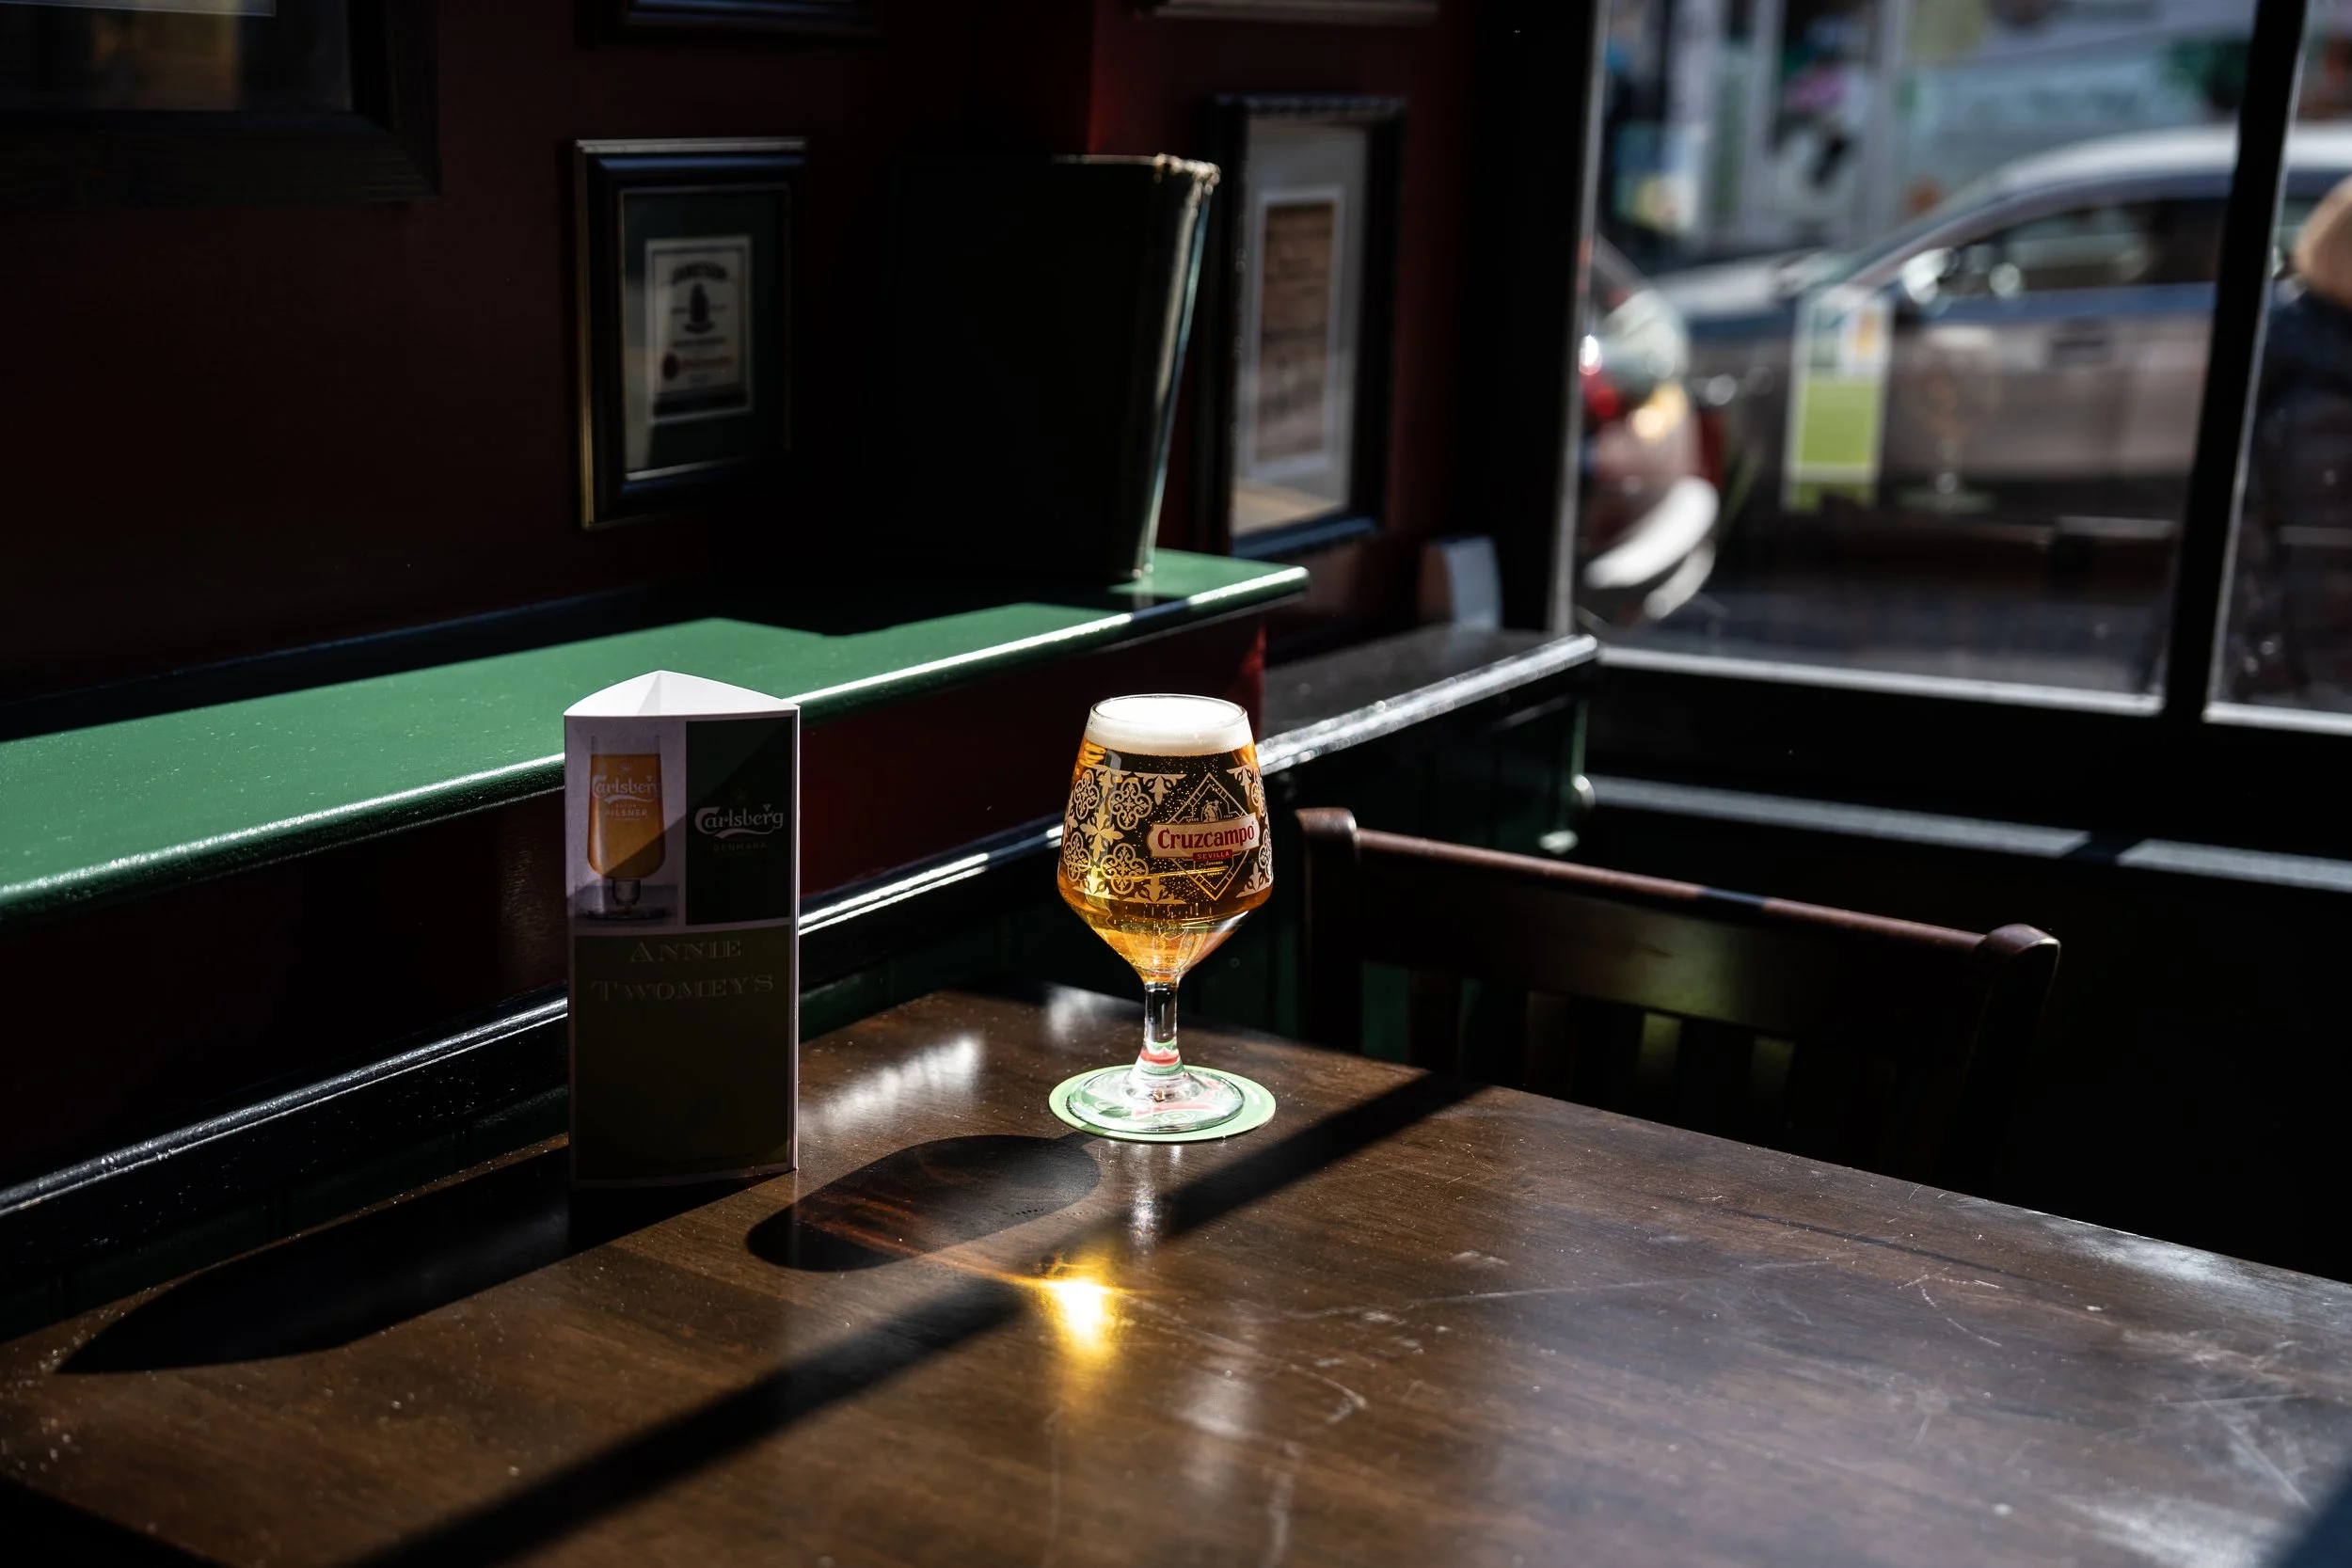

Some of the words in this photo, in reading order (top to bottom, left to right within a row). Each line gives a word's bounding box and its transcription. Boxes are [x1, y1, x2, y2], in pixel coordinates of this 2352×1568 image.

[694, 803, 784, 835] Carlsberg
[1157, 825, 1255, 849] Cruzcampo
[1197, 850, 1231, 860] SEVILLA
[627, 939, 741, 963] ANNIE
[590, 974, 773, 1002] TWOMEY'S
